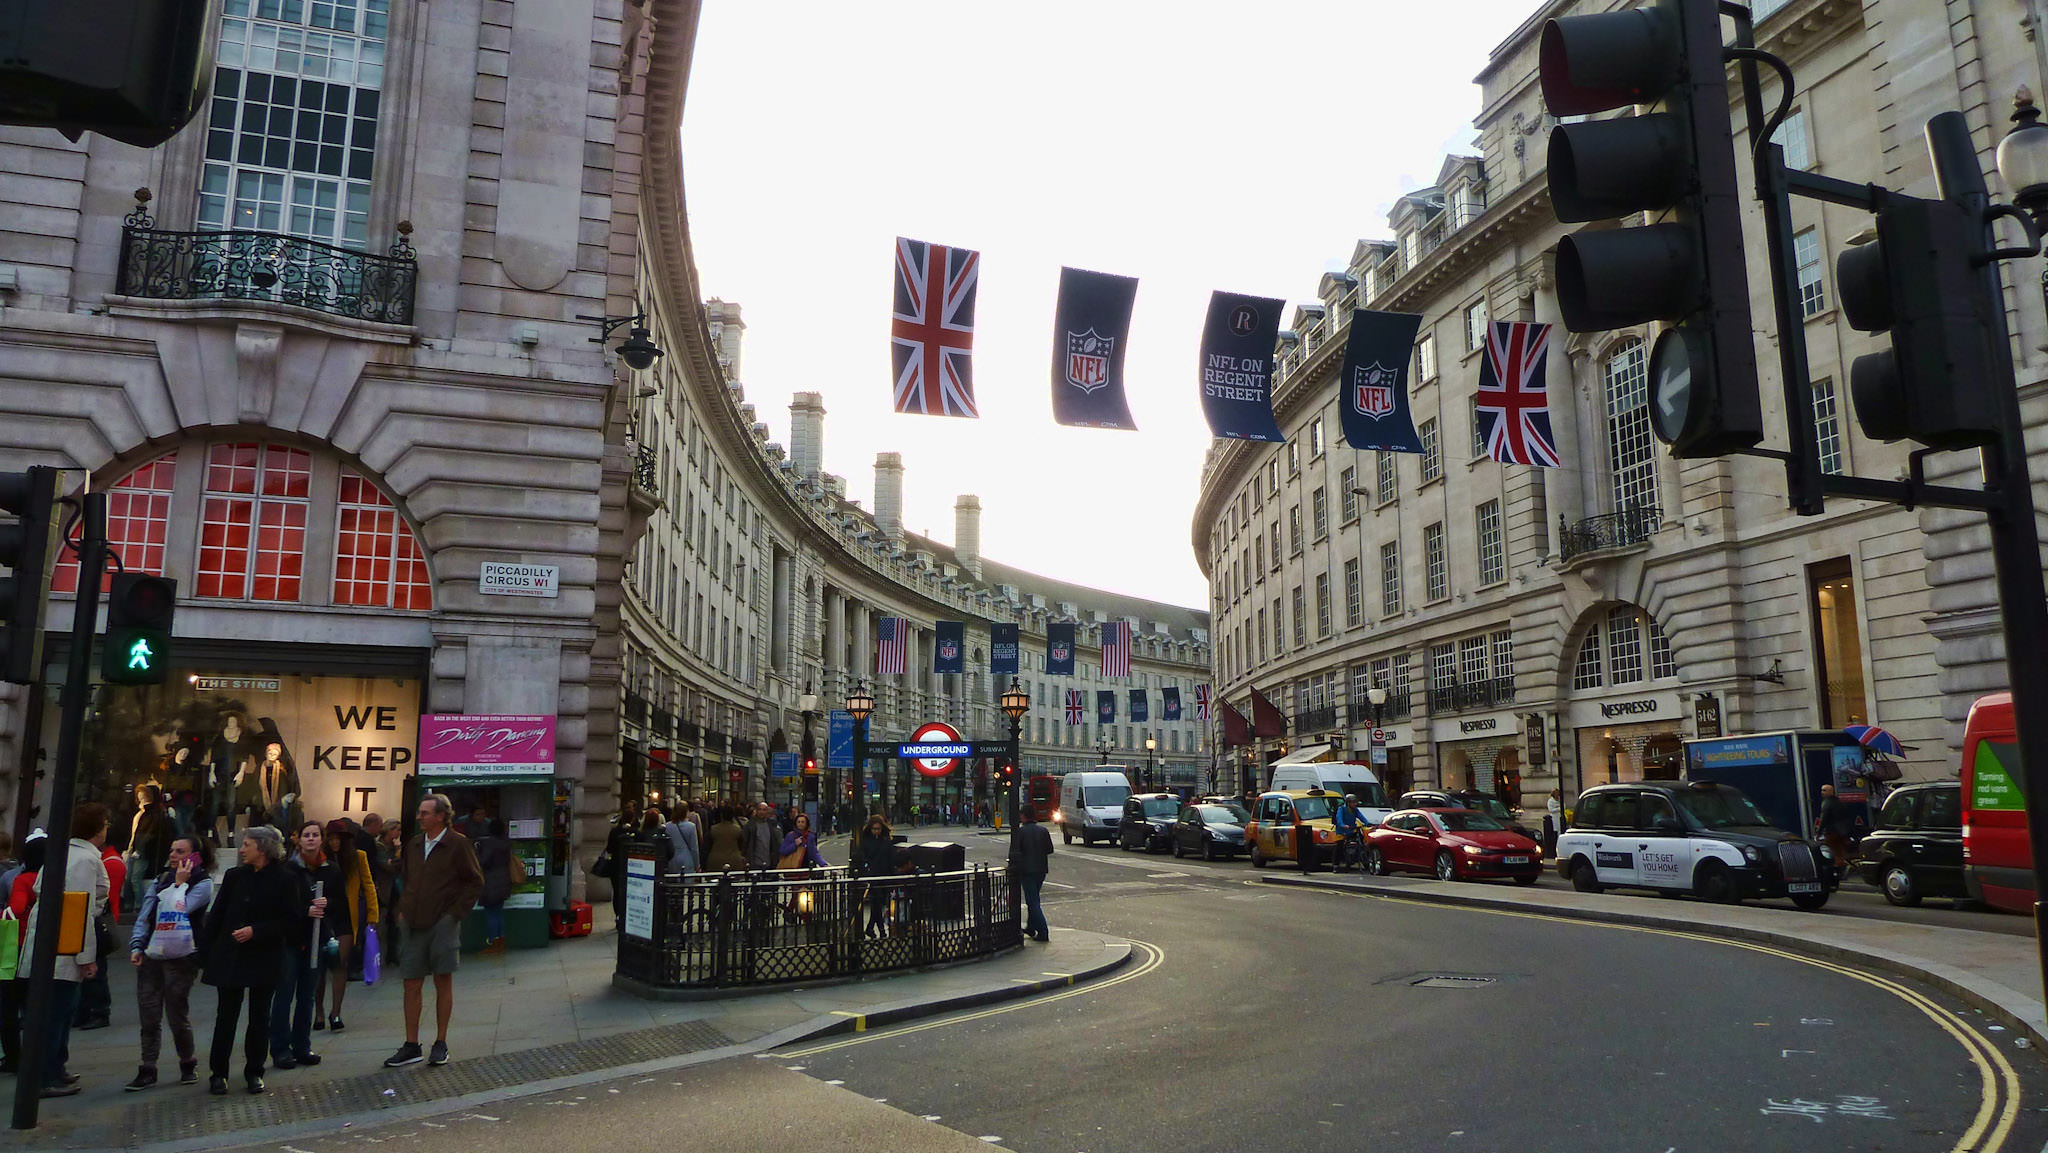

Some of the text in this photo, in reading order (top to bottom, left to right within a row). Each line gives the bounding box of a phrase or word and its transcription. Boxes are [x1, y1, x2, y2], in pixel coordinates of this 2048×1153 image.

[1208, 353, 1263, 373] NFL ON
[1071, 355, 1105, 385] NFL
[1204, 368, 1266, 388] REGENT
[1205, 384, 1264, 402] STREET
[1358, 386, 1391, 413] NFL
[486, 565, 553, 577] PICCADILLY
[485, 575, 548, 587] CIRCUS W1
[941, 647, 957, 658] NFL
[1053, 649, 1068, 659] NFL
[199, 679, 278, 690] THE STING
[1598, 700, 1657, 719] NESPRESSO
[334, 705, 397, 731] WE
[1459, 718, 1496, 734] NESPRESSO
[429, 723, 547, 752] Dirty Dancing
[902, 745, 969, 754] UNDERGROUND
[1747, 749, 1770, 759] TOURS
[313, 746, 412, 771] KEEP
[1977, 772, 2004, 783] Turning
[1978, 784, 2008, 793] red vans
[343, 787, 377, 812] IT
[1977, 798, 1998, 807] green
[1642, 853, 1674, 862] LET'S GET
[1643, 863, 1679, 873] YOU HOME
